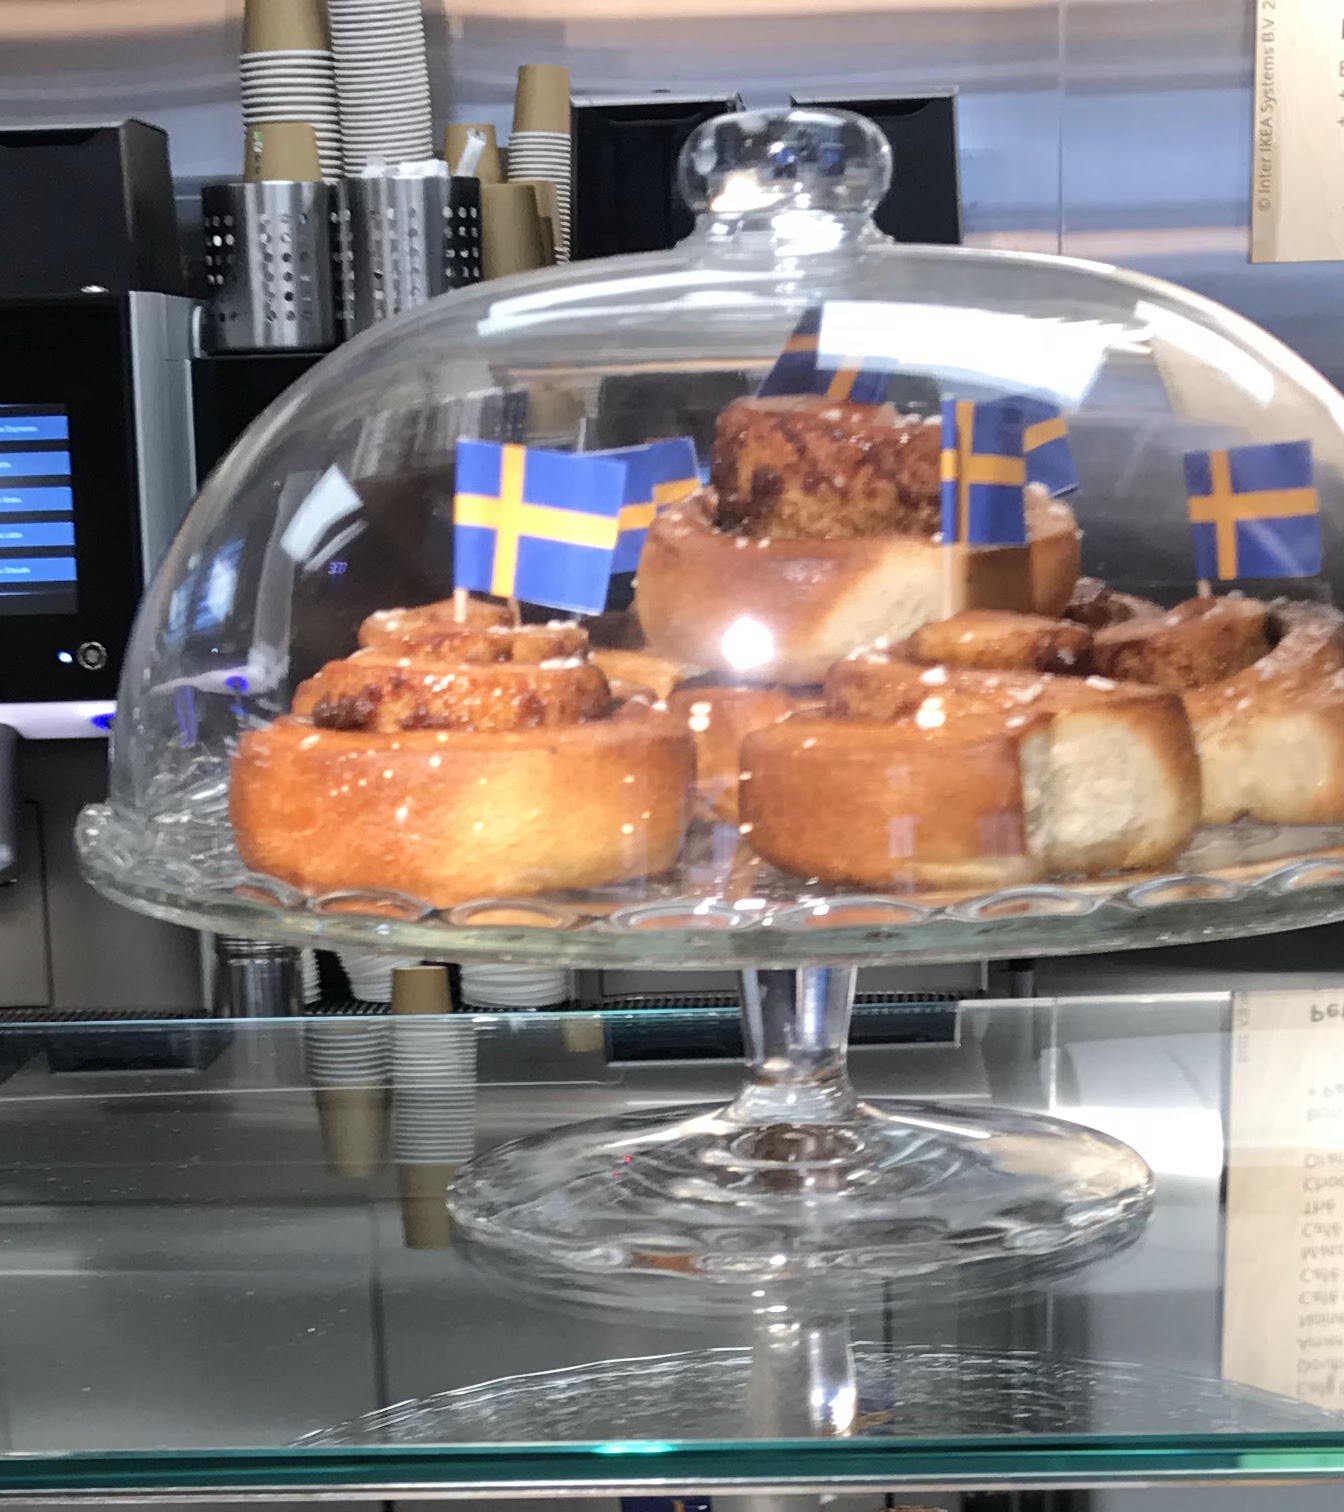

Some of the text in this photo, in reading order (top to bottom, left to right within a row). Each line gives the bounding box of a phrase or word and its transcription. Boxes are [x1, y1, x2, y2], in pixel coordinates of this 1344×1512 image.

[1260, 47, 1278, 113] Systems
[1260, 116, 1273, 152] IKEA
[1259, 157, 1272, 193] Inter
